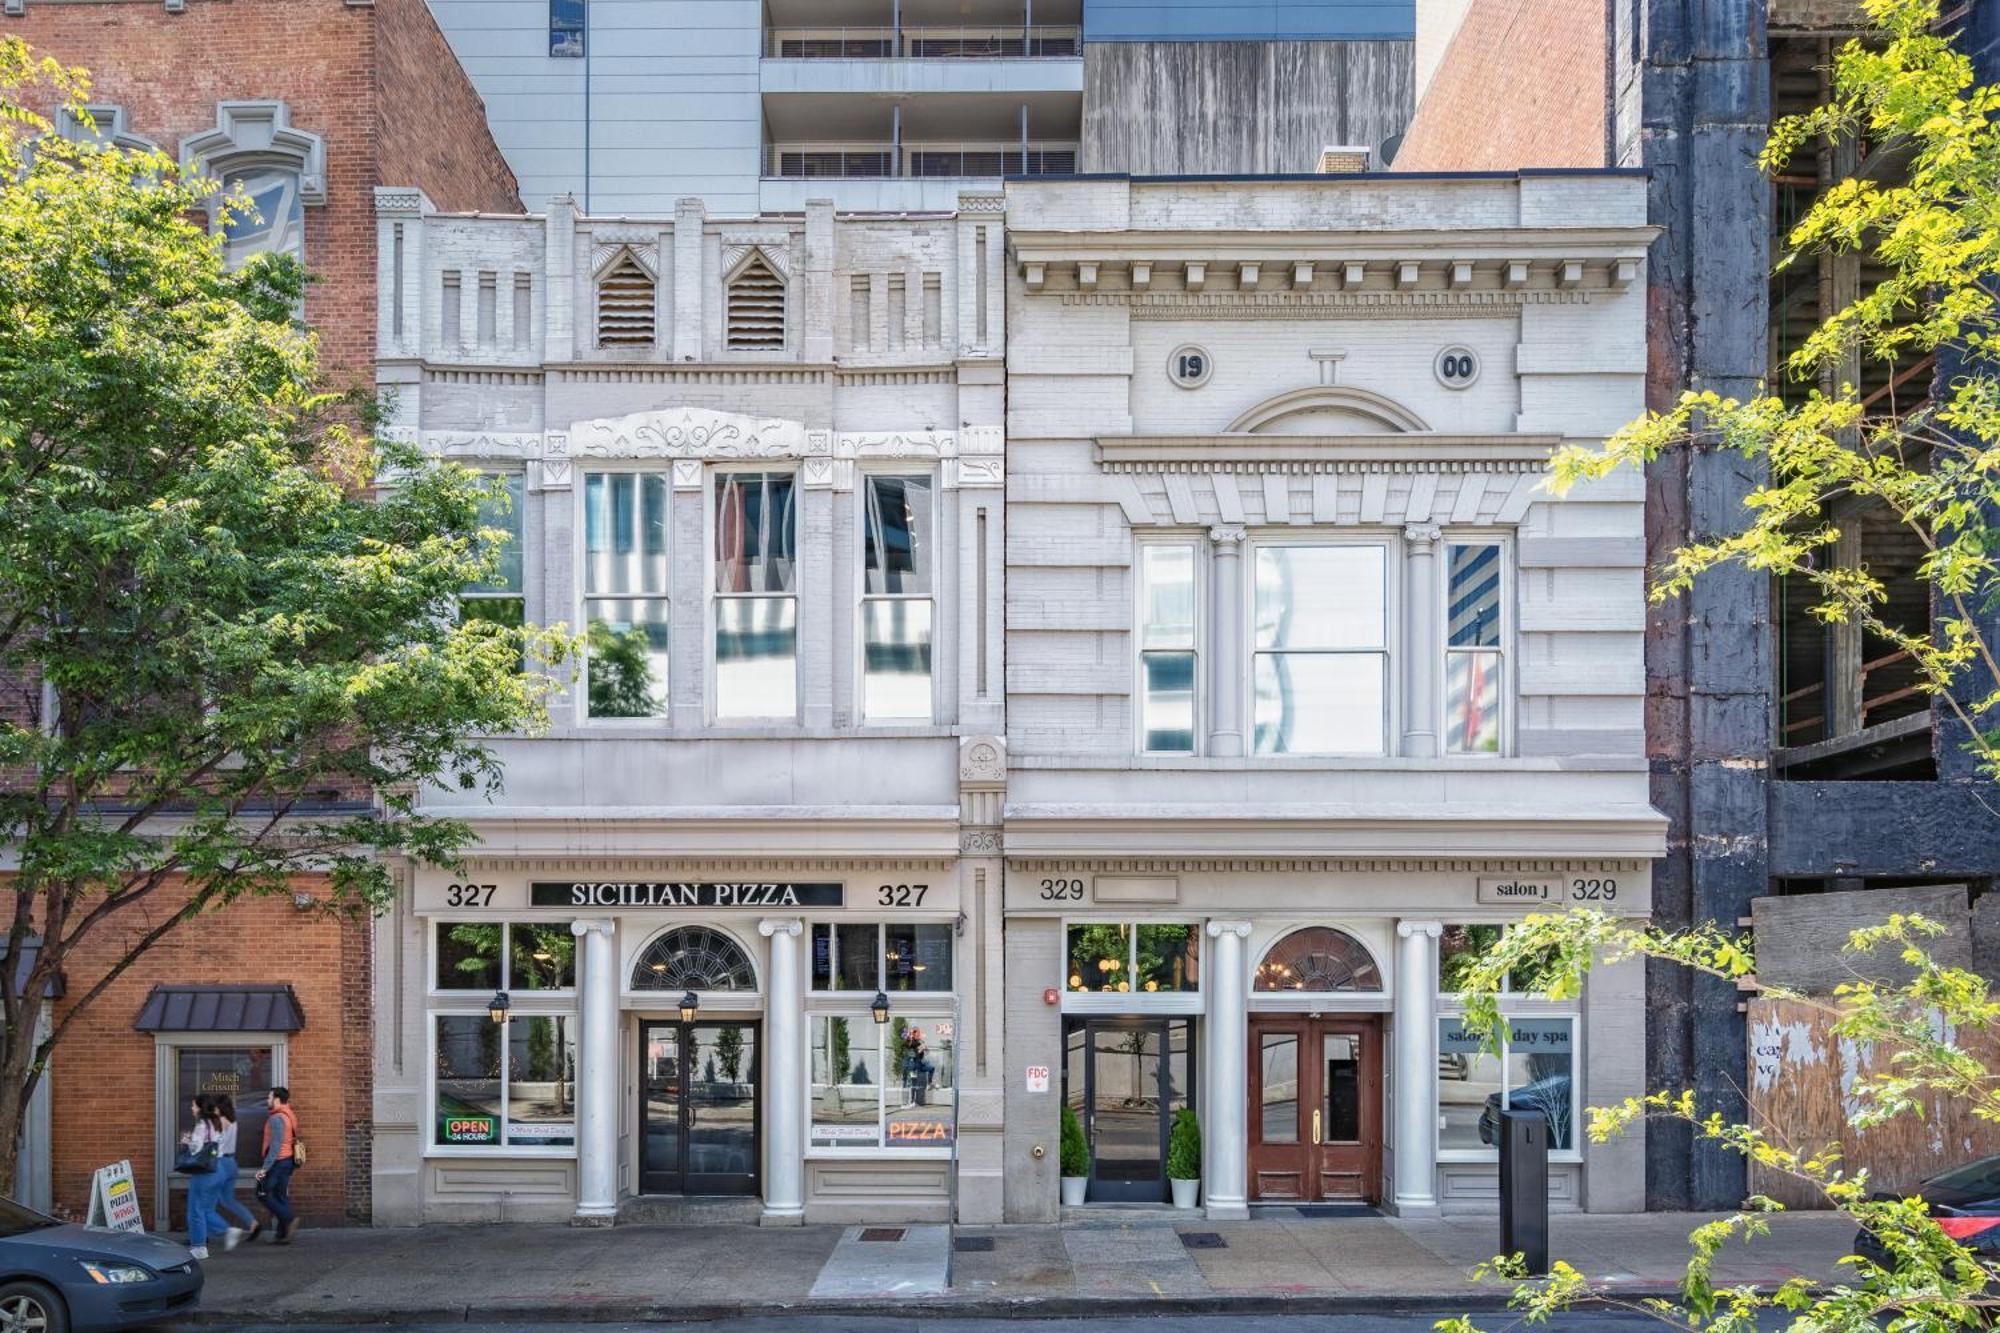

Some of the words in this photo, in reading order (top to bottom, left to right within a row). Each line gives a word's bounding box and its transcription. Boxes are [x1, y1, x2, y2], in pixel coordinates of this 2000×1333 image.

[1179, 355, 1202, 378] 19
[1443, 355, 1473, 378] 00
[447, 884, 497, 907] 327
[571, 883, 699, 906] SICILIAN
[714, 884, 800, 906] PIZZA
[878, 884, 929, 907] 327
[1040, 879, 1084, 900] 329
[1496, 881, 1538, 896] salon
[1572, 879, 1617, 900] 329
[1512, 1028, 1538, 1044] day
[1543, 1031, 1569, 1044] spa
[1028, 1067, 1048, 1078] FDC
[450, 1120, 489, 1133] OPEN
[889, 1121, 946, 1139] PIZZA
[462, 1133, 487, 1141] HOURS
[110, 1194, 129, 1208] PIZZA
